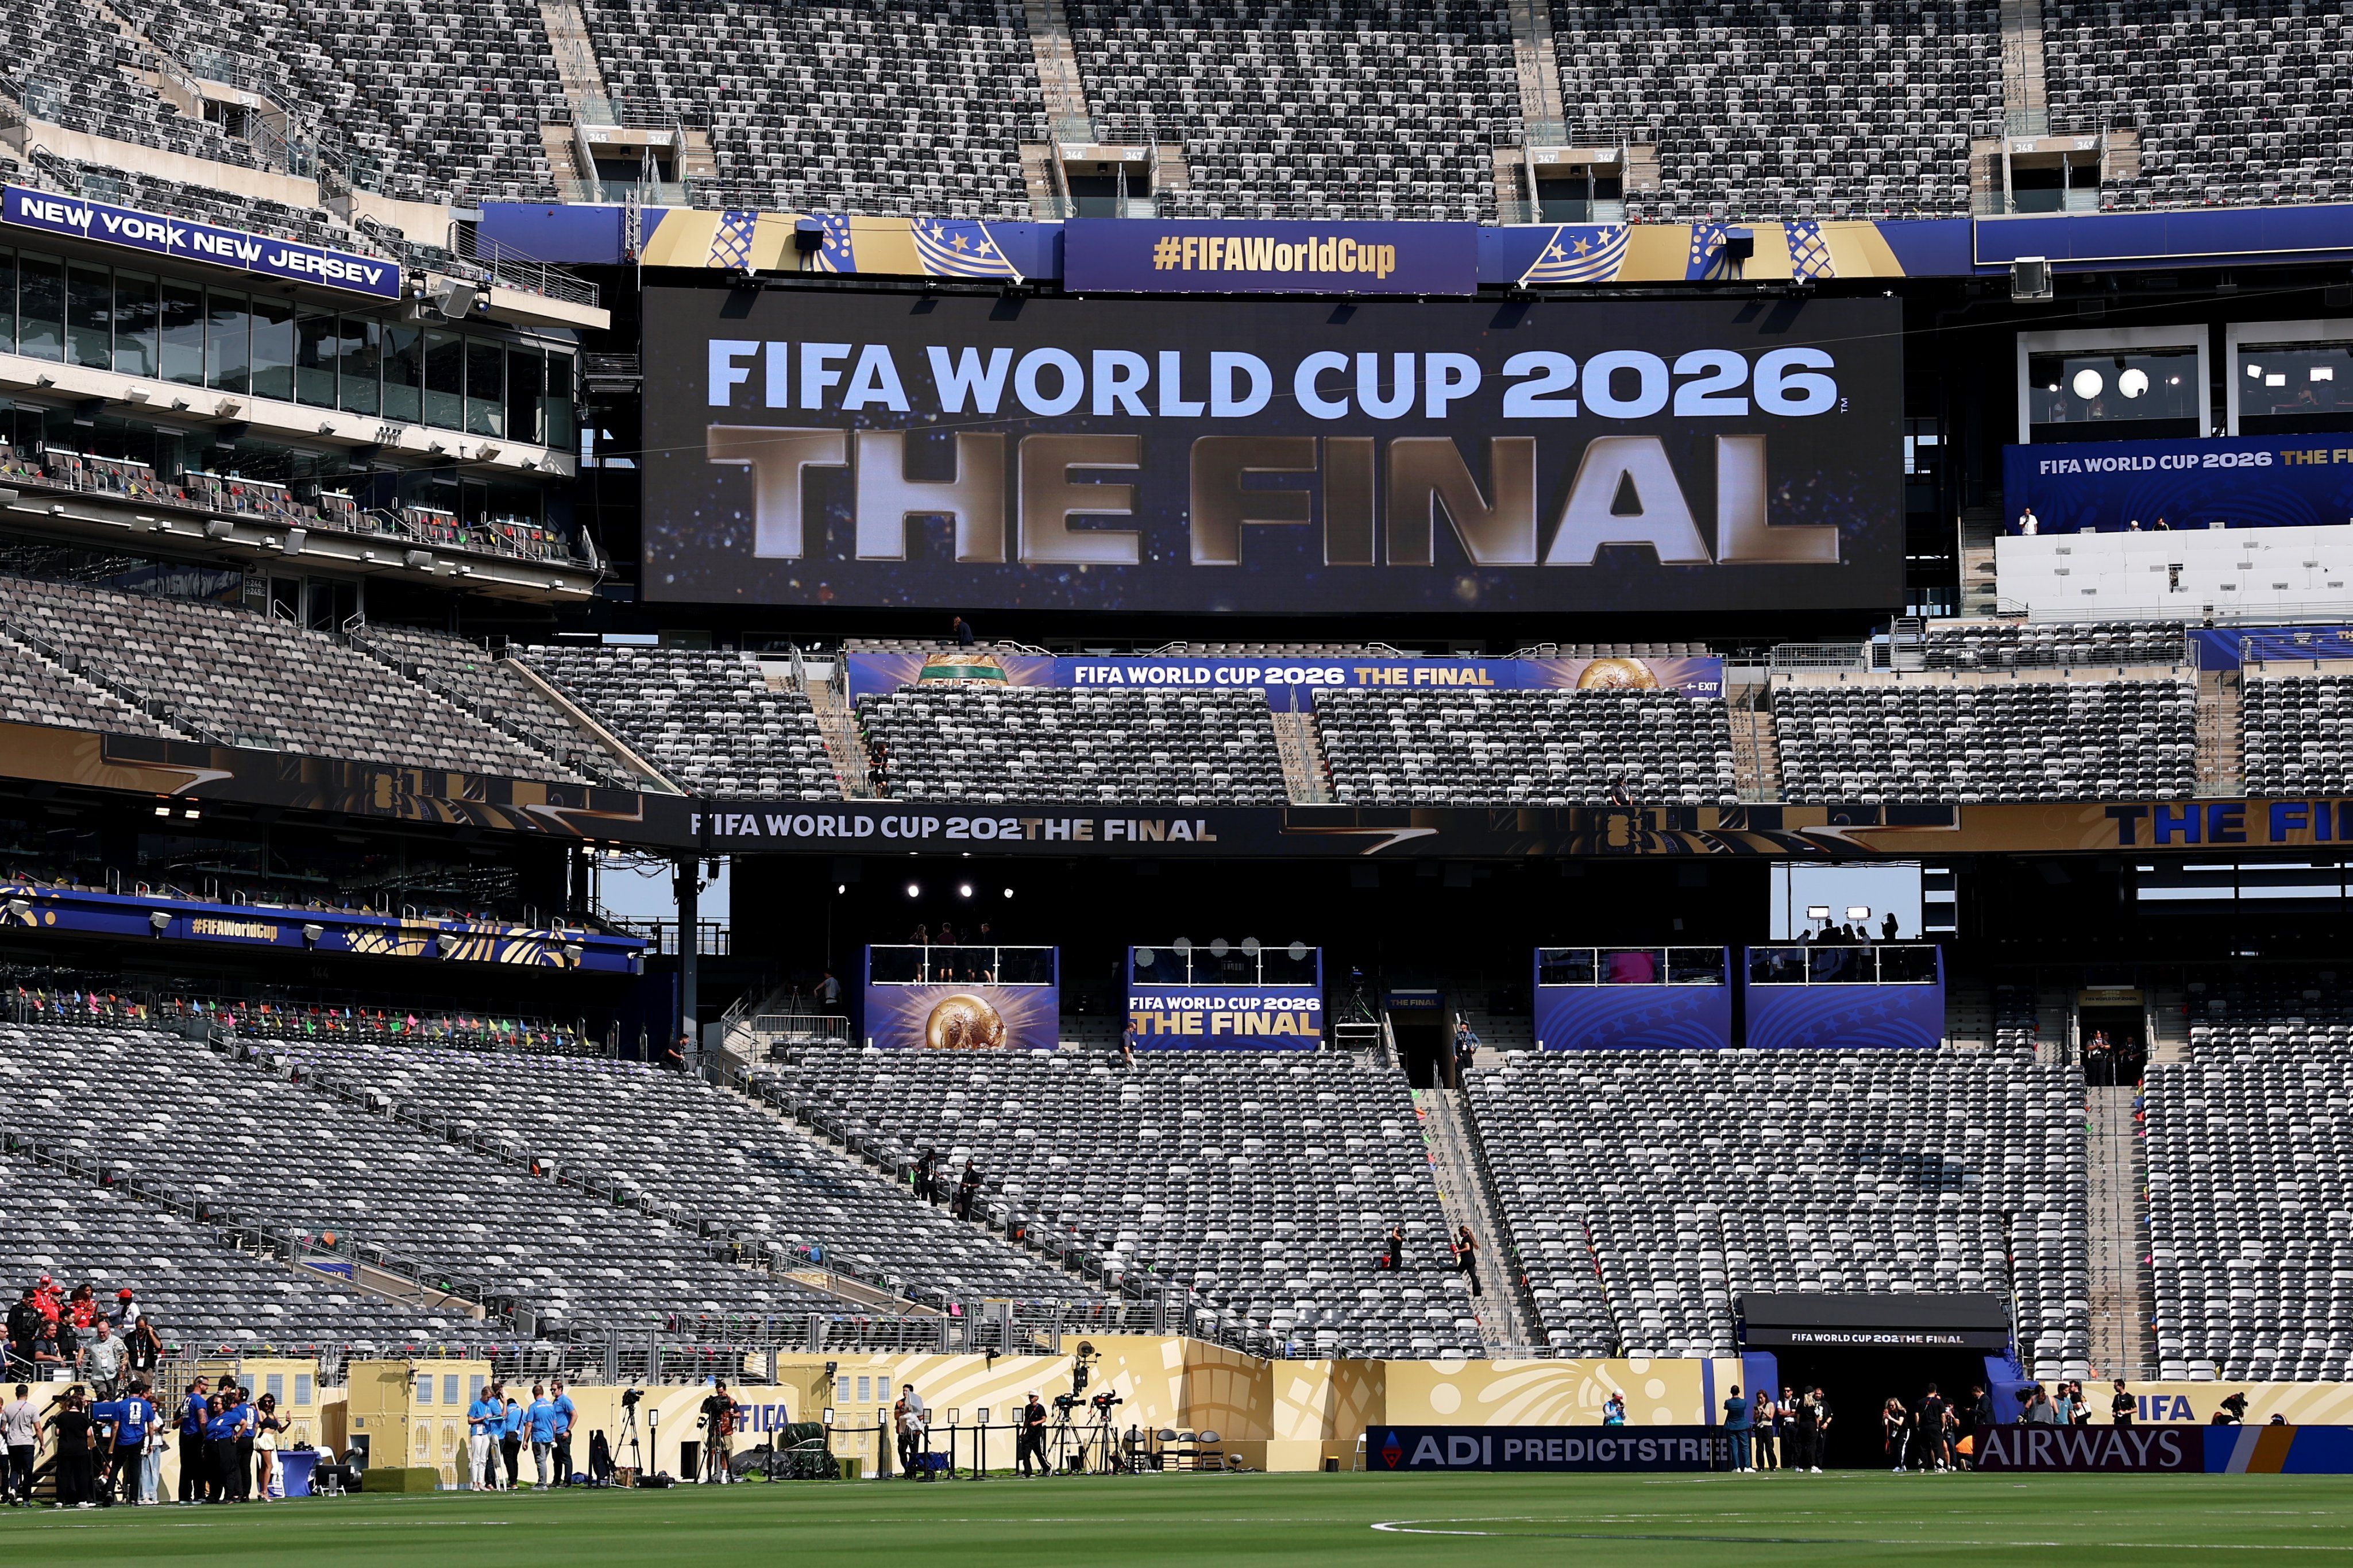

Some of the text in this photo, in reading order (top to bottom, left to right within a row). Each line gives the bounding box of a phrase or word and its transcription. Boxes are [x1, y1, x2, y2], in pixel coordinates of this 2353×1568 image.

[589, 133, 606, 142] 345
[651, 135, 668, 145] 346
[2016, 144, 2034, 152] 348
[2077, 141, 2094, 149] 349
[1066, 150, 1082, 159] 346
[1126, 151, 1143, 160] 347
[1538, 155, 1555, 163] 347
[1598, 153, 1614, 162] 348
[21, 196, 383, 285] NEW YORK NEW JERSEY
[1154, 237, 1395, 279] #FIFAWorldCup
[708, 339, 909, 414] FIFA
[926, 346, 1272, 419] WORLD
[1294, 351, 1481, 420] CUP
[1502, 347, 1838, 419] 2026
[2040, 459, 2081, 474] FIFA
[2085, 457, 2155, 472] WORLD
[2159, 454, 2198, 469] CUP
[2203, 451, 2272, 468] 2026
[2280, 450, 2328, 465] THE
[708, 424, 1842, 567] THE FINAL
[1075, 667, 1494, 686] FIFA WORLD CUP 2026 THE FINAL
[1699, 682, 1718, 692] EXIT
[691, 813, 760, 836] FIFA
[765, 814, 874, 837] WORLD
[880, 816, 940, 839] CUP
[1104, 820, 1217, 842] FINAL
[2105, 803, 2246, 845] THE
[192, 918, 277, 941] #FIFAWorldCup
[311, 967, 329, 978] 144
[1129, 997, 1321, 1010] FIFA WORLD CUP 2026
[1131, 1012, 1320, 1035] THE FINAL
[1792, 1334, 1812, 1342] FIFA
[1815, 1334, 1850, 1342] WORLD
[1852, 1334, 1872, 1342] CUP
[1926, 1335, 1964, 1343] FINAL
[739, 1404, 789, 1432] FIFA
[2137, 1396, 2195, 1420] IFA
[1410, 1435, 1732, 1465] ADI PREDICTSTREE
[1978, 1429, 2183, 1467] AIRWAYS
